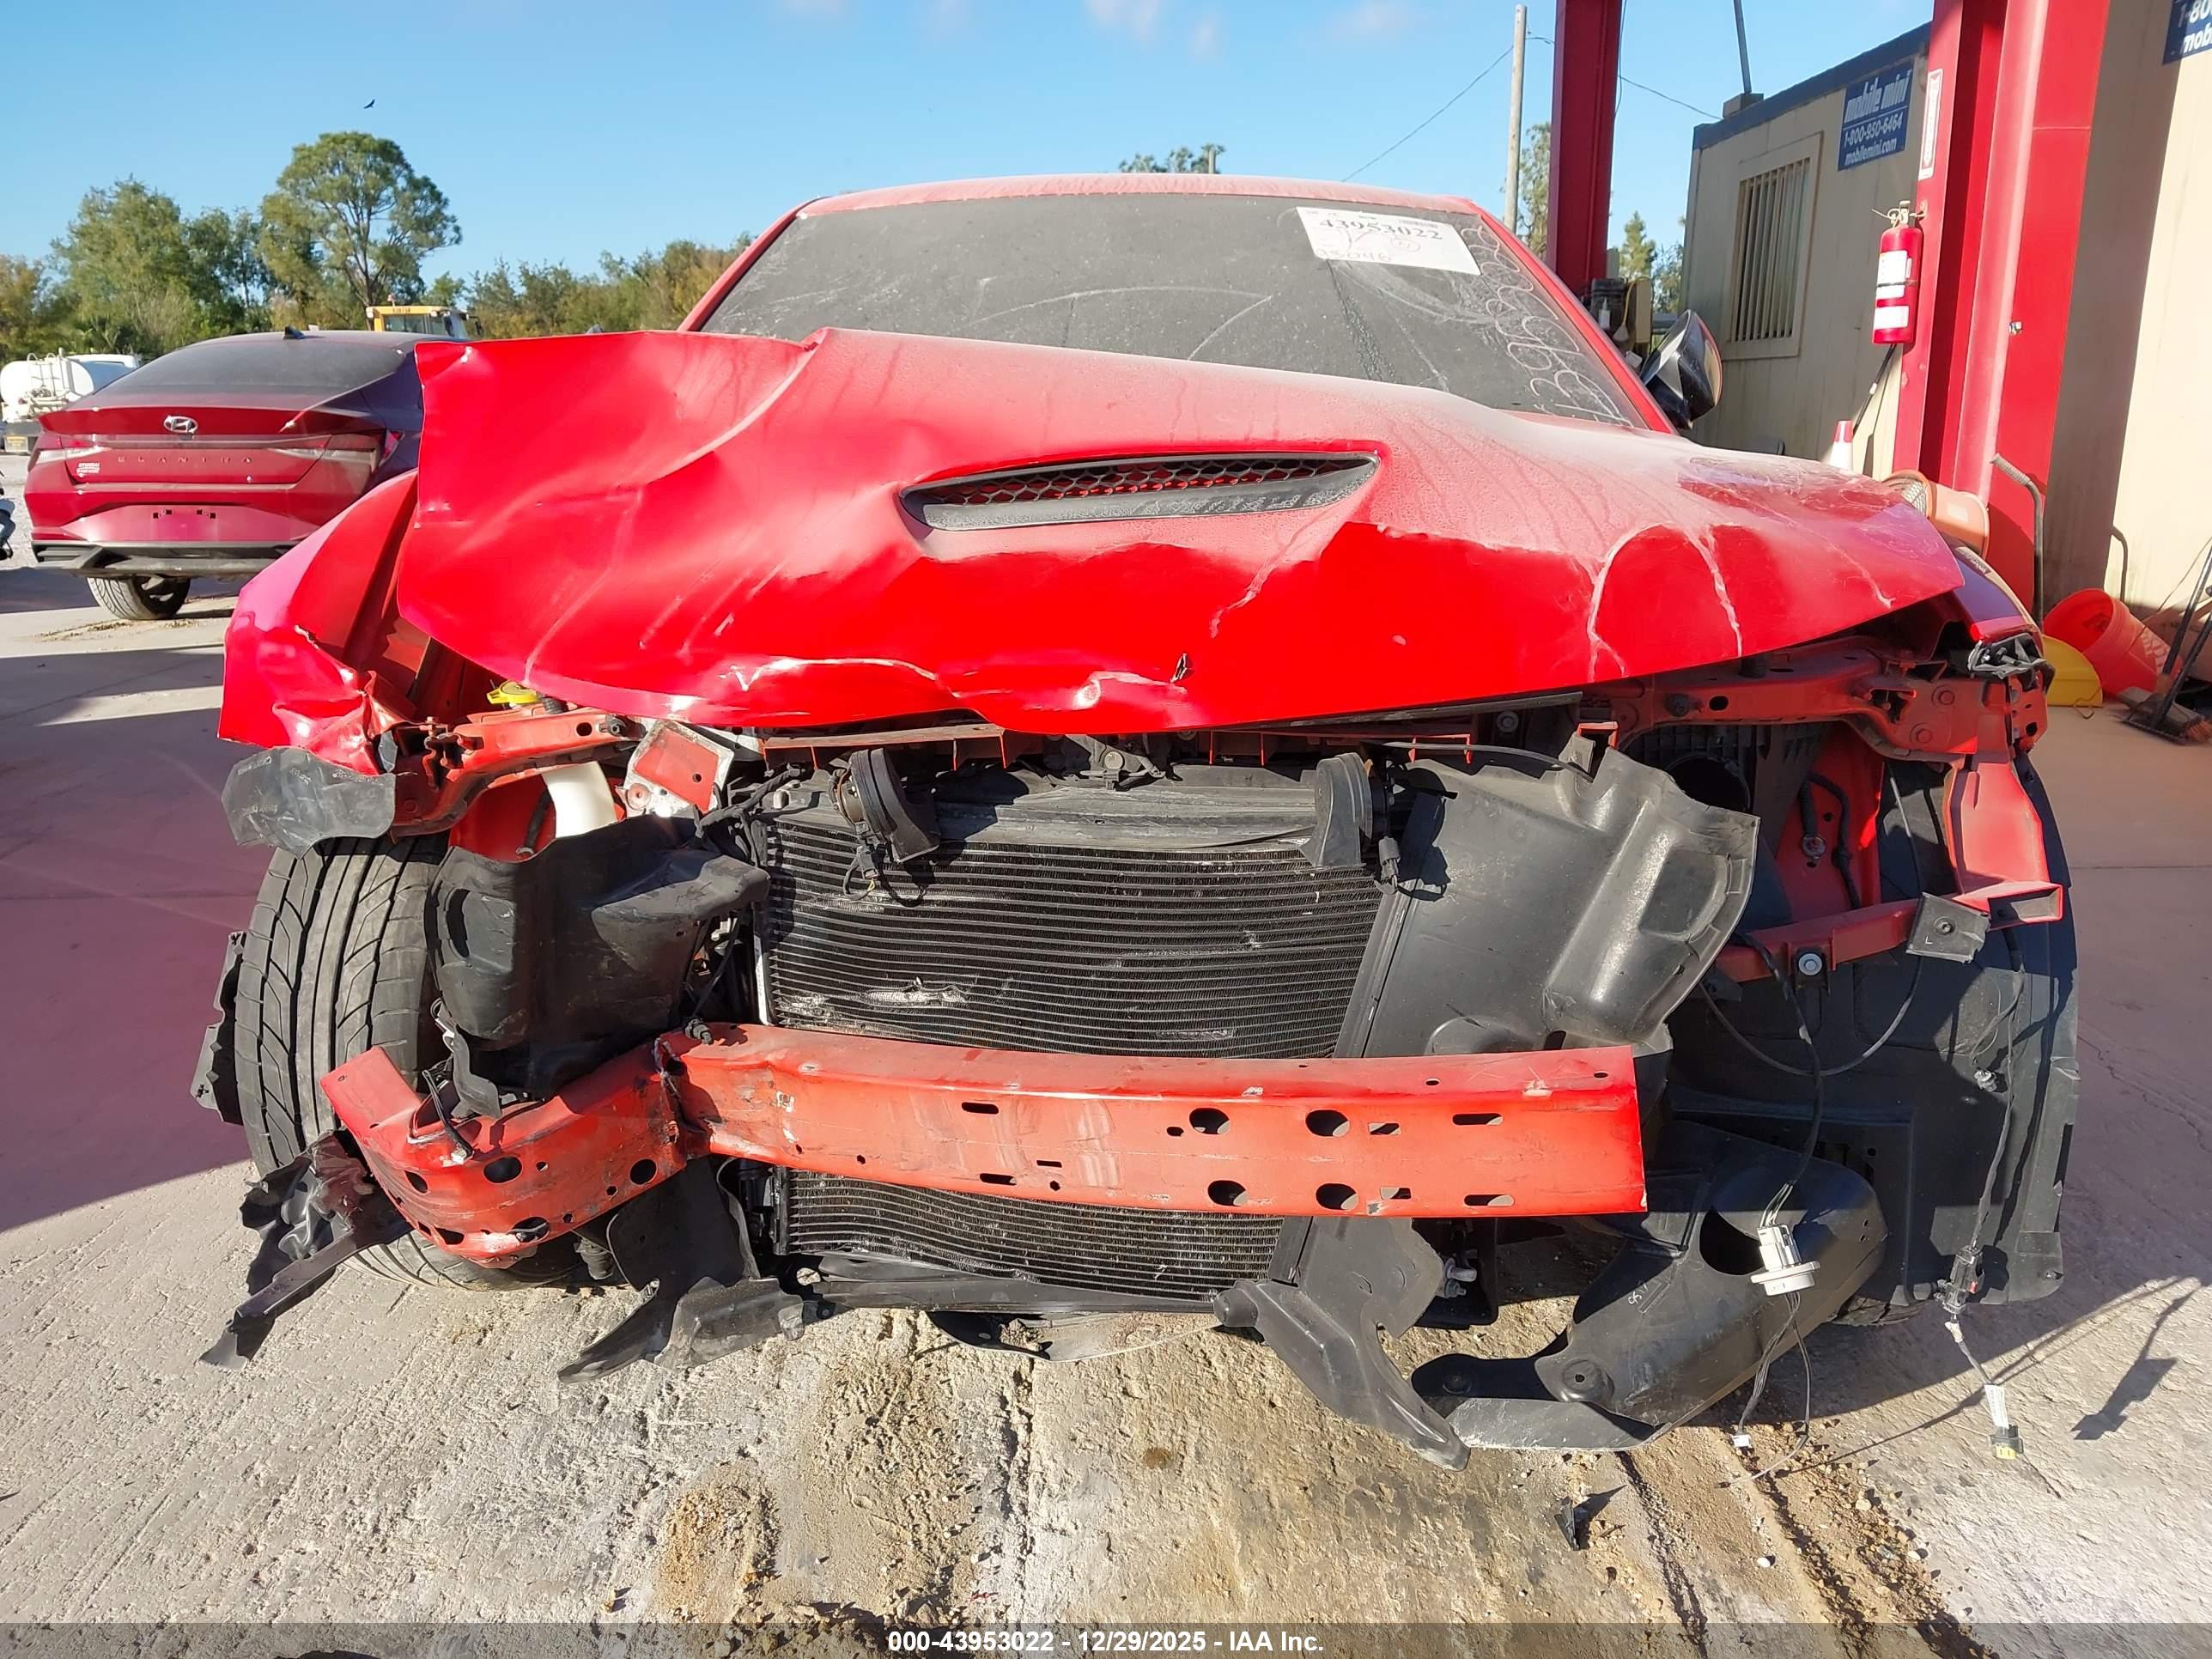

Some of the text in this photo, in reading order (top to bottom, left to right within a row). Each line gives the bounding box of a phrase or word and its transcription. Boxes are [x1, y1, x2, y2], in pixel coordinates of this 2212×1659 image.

[2178, 0, 2212, 27] 1-80
[2180, 22, 2212, 53] mob
[1844, 77, 1882, 123] mobile
[1881, 69, 1912, 109] mini
[1844, 111, 1904, 148] 1-800-950-6464
[1844, 137, 1897, 166] mobilemini.com
[1319, 219, 1443, 240] 43953022
